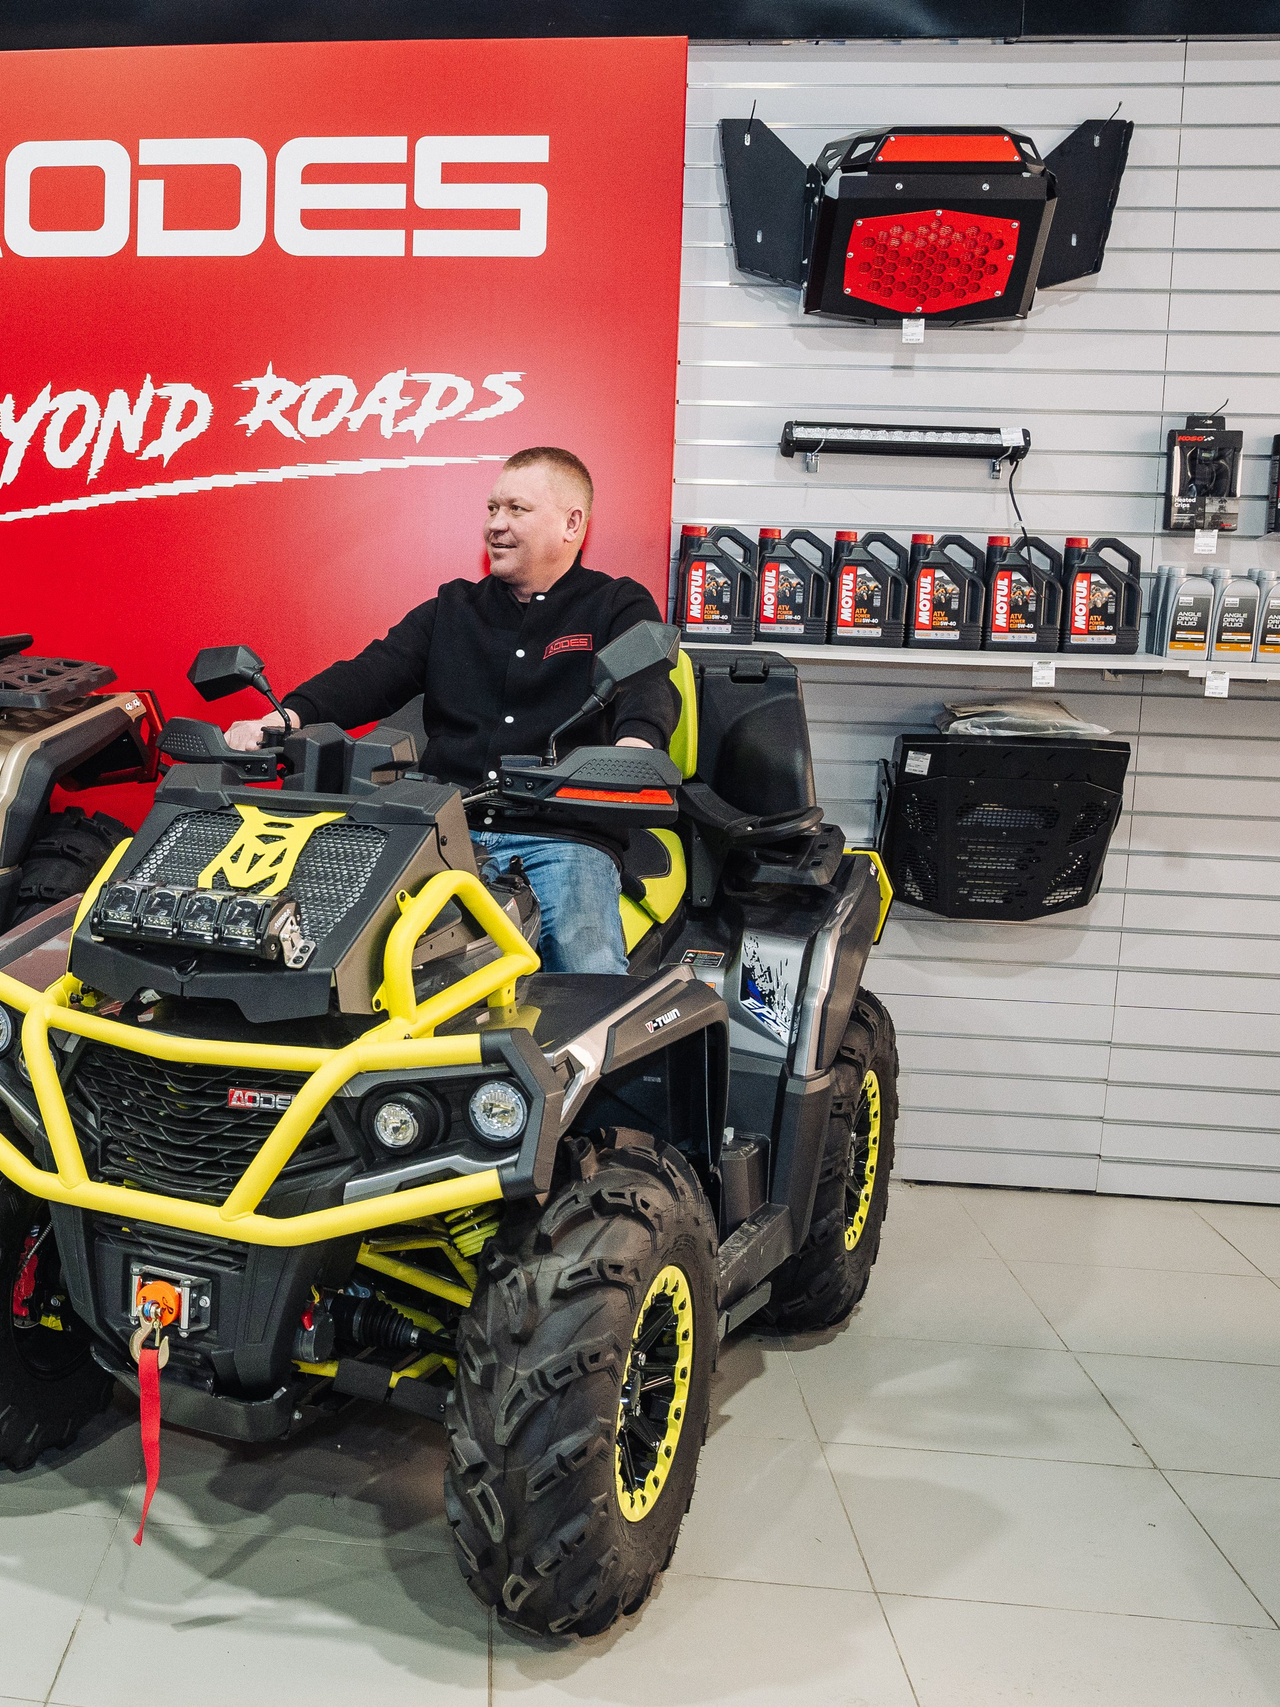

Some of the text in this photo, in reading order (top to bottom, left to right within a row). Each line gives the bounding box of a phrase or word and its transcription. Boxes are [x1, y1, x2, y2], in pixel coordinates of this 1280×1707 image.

[233, 361, 527, 442] ROADS
[689, 569, 703, 618] MOTUL
[763, 570, 776, 618] MOTUL
[841, 573, 854, 621] MOTUL
[919, 576, 931, 625] MOTUL
[995, 578, 1008, 627] MOTUL
[1074, 580, 1087, 629] MOTUL
[231, 1090, 297, 1111] AODE
